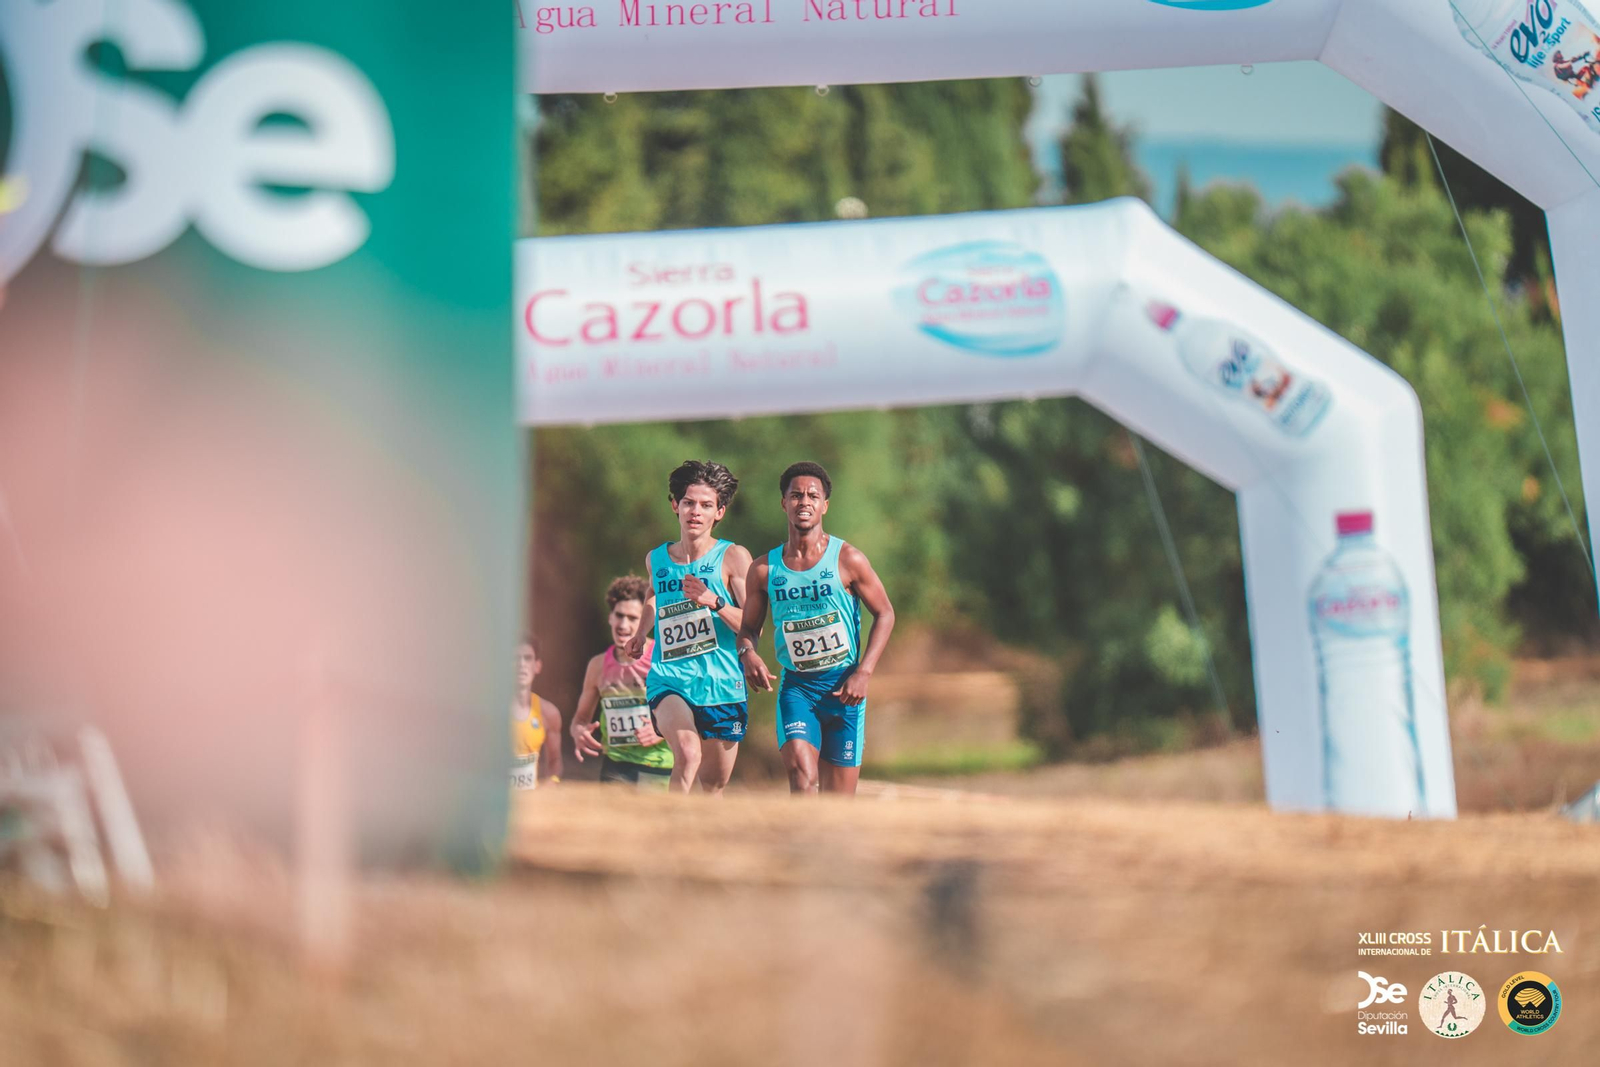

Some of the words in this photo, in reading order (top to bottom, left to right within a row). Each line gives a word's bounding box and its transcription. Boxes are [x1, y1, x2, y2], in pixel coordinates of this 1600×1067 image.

[618, 0, 775, 27] Mineral
[802, 0, 961, 22] Natural
[524, 277, 809, 347] Cazorla
[774, 580, 833, 602] nerja
[663, 618, 711, 645] 8204
[792, 632, 844, 657] 8211
